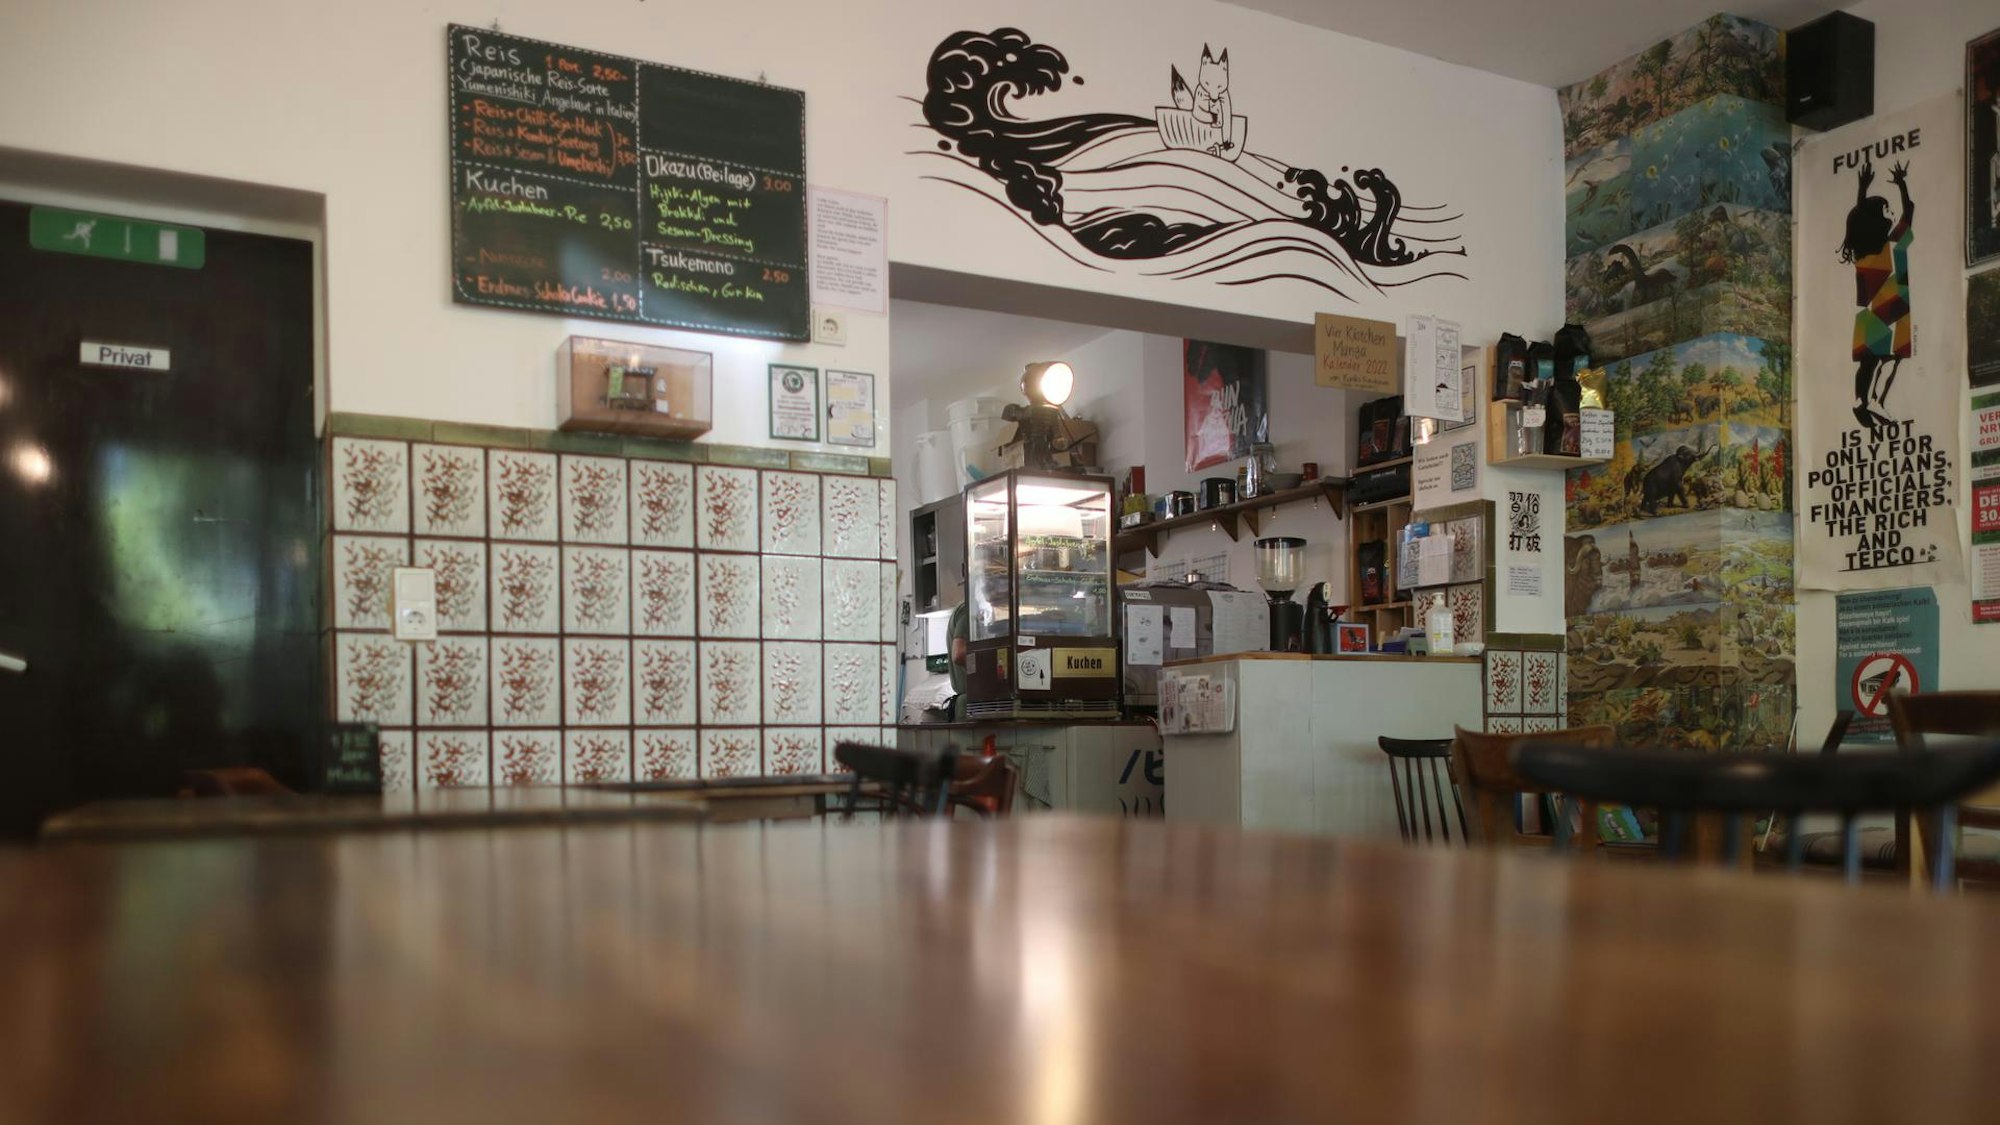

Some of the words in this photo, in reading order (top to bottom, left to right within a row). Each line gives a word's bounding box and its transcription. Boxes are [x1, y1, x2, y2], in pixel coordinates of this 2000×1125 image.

[462, 35, 521, 65] Reis
[1833, 128, 1921, 174] FUTURE
[466, 169, 548, 200] Kuchen
[727, 197, 752, 209] mit
[599, 213, 632, 231] 2,50
[713, 212, 737, 226] und
[646, 248, 734, 275] Tsukemono
[99, 346, 152, 367] Privat
[1366, 359, 1388, 375] 2022
[1842, 430, 1861, 449] IS
[1870, 419, 1915, 443] NOT
[1980, 423, 2000, 434] NR
[1826, 443, 1880, 468] ONLY
[1889, 435, 1933, 458] FOR
[1808, 451, 1952, 489] POLITICIANS,
[1831, 469, 1952, 502] OFFICIALS,
[1811, 488, 1952, 523] FINANCIERS,
[1979, 494, 2000, 508] DE
[1825, 517, 1867, 538] THE
[1875, 508, 1927, 532] RICH
[1857, 530, 1901, 552] AND
[1845, 546, 1915, 570] TEPCO
[1067, 655, 1102, 670] Kuchen
